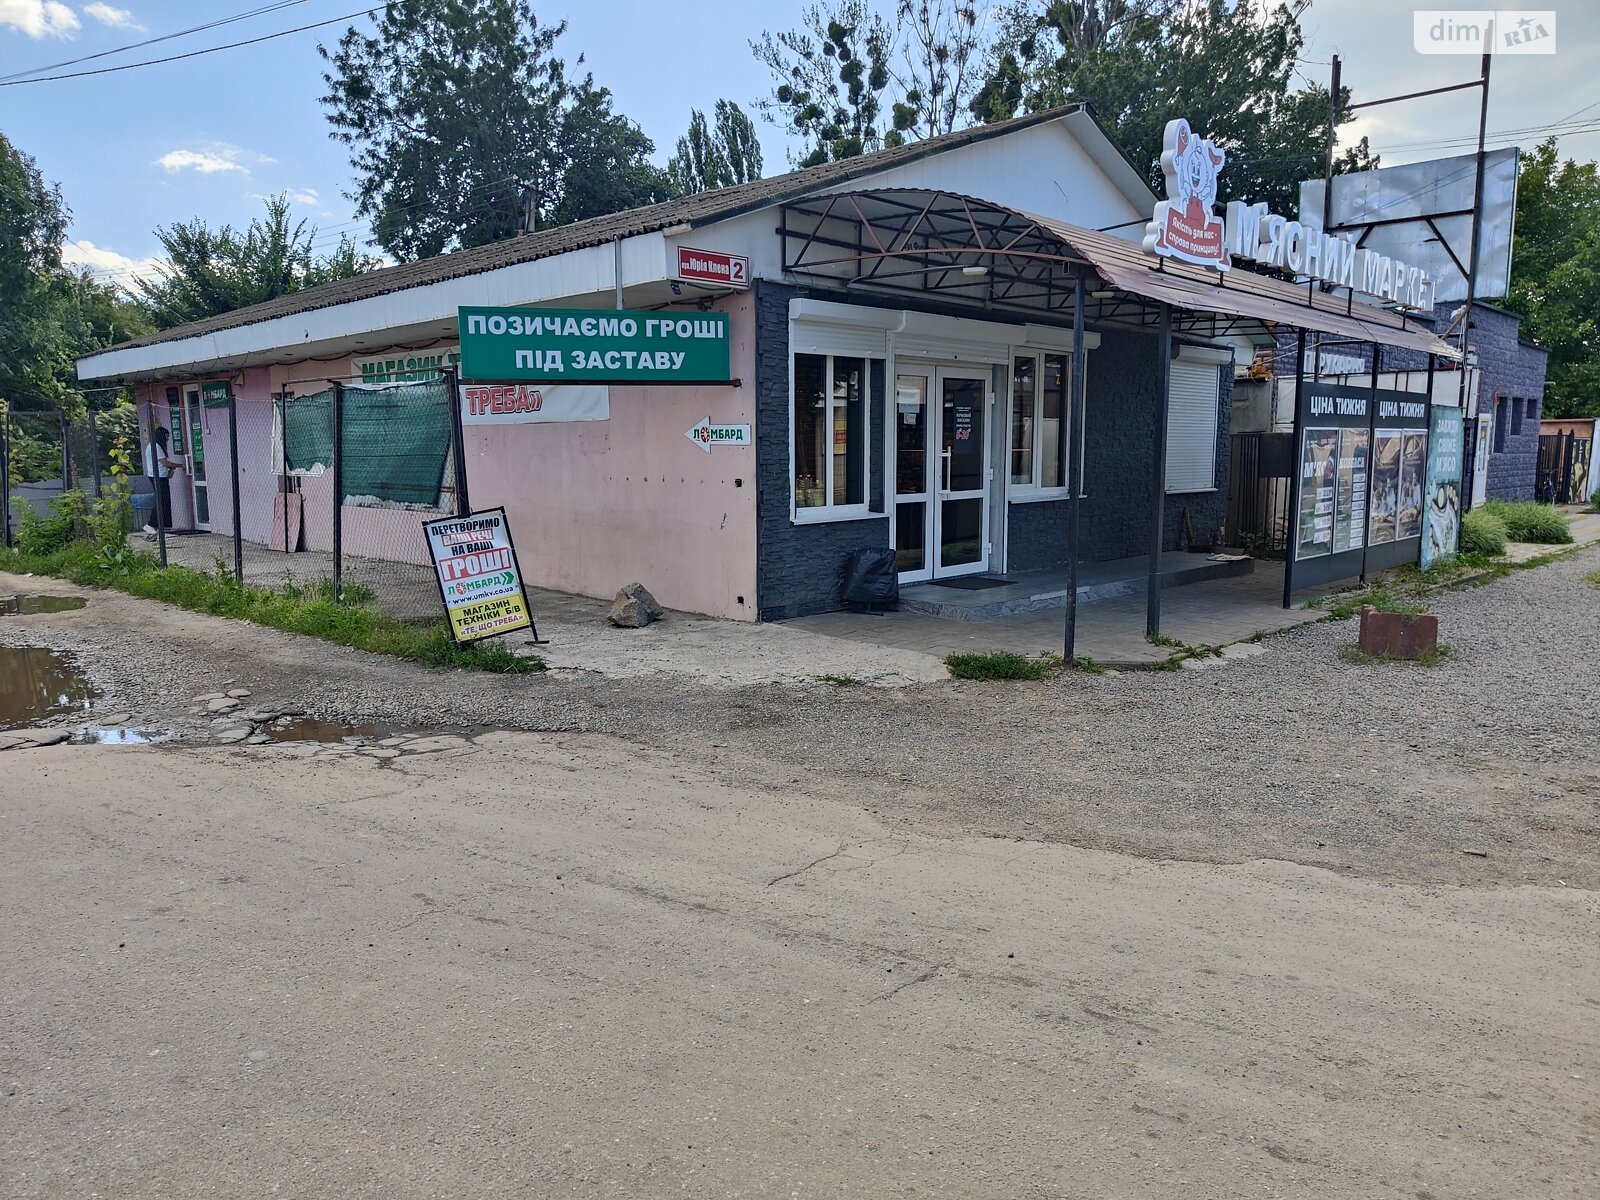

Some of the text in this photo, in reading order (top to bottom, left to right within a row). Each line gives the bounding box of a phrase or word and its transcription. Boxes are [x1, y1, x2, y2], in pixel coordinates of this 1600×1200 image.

[733, 261, 744, 280] 2
[467, 315, 724, 339] ПОЗИЧАЄМО ГРОШІ
[362, 354, 444, 384] МАГАЗИН
[515, 350, 686, 372] ПІД ЗАСТАВУ
[1303, 350, 1365, 375] ПРУКАРНЯ
[465, 384, 543, 416] ТРЕБА»
[1310, 396, 1367, 417] ЦІНА ТИЖНЯ
[1379, 400, 1425, 420] ЦІНА ТИЖНЯ
[693, 426, 744, 443] ЛОМБАРД
[431, 517, 500, 536] ПЕРЕТВОРИМО
[443, 529, 493, 547] ВАШІ РЕЧІ
[451, 544, 466, 557] НА
[440, 548, 510, 582] ГРОШІ
[448, 576, 502, 596] ЛОМБАРД
[452, 586, 514, 605] www.umkv.co.ua
[456, 604, 521, 627] ТЕХНІКИ Б/В
[462, 599, 511, 617] МАГАЗИН
[479, 621, 493, 631] ЩО
[493, 614, 524, 627] ТРЕБА»
